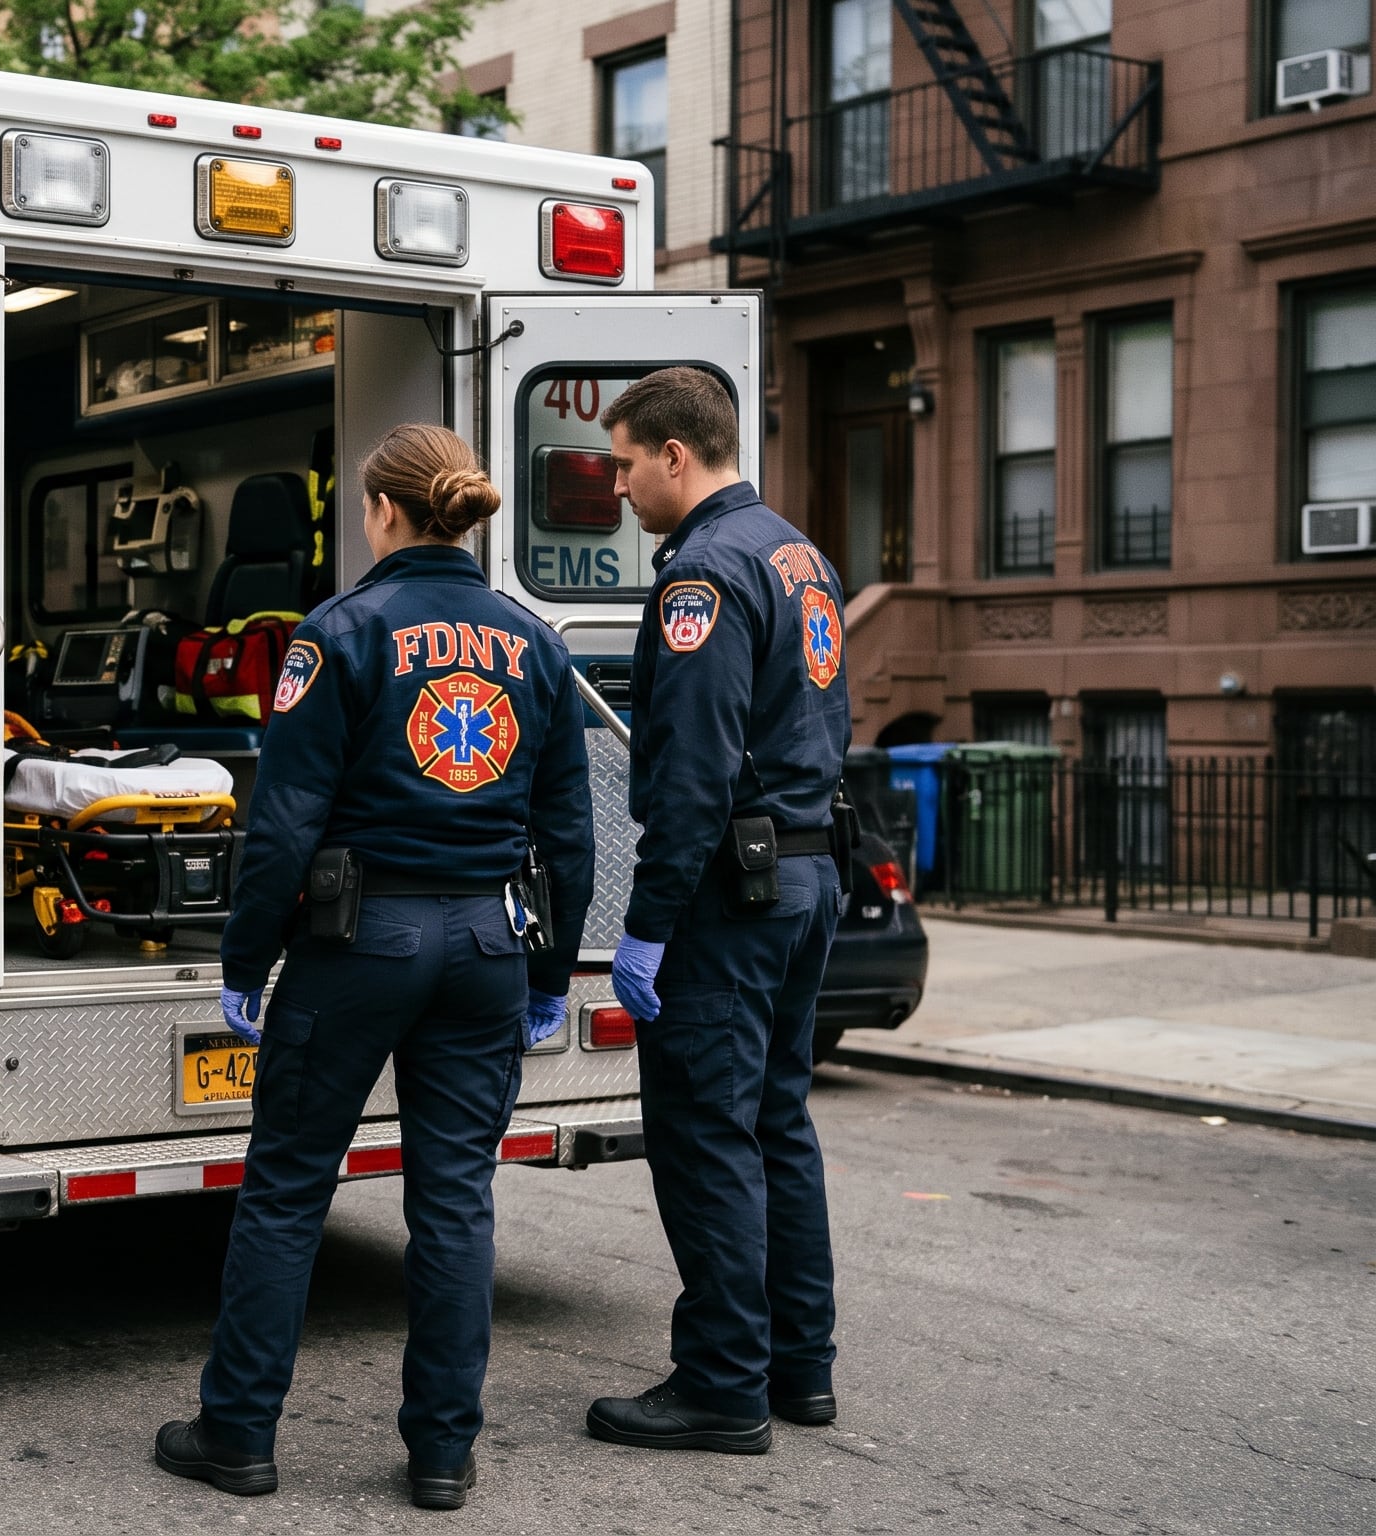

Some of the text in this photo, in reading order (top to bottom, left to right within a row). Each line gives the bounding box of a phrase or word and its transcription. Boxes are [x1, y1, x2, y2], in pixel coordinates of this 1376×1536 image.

[544, 379, 600, 422] 40
[531, 545, 620, 588] EMS
[392, 622, 528, 680] FDNY
[448, 681, 480, 695] EMS
[448, 769, 478, 782] 1855
